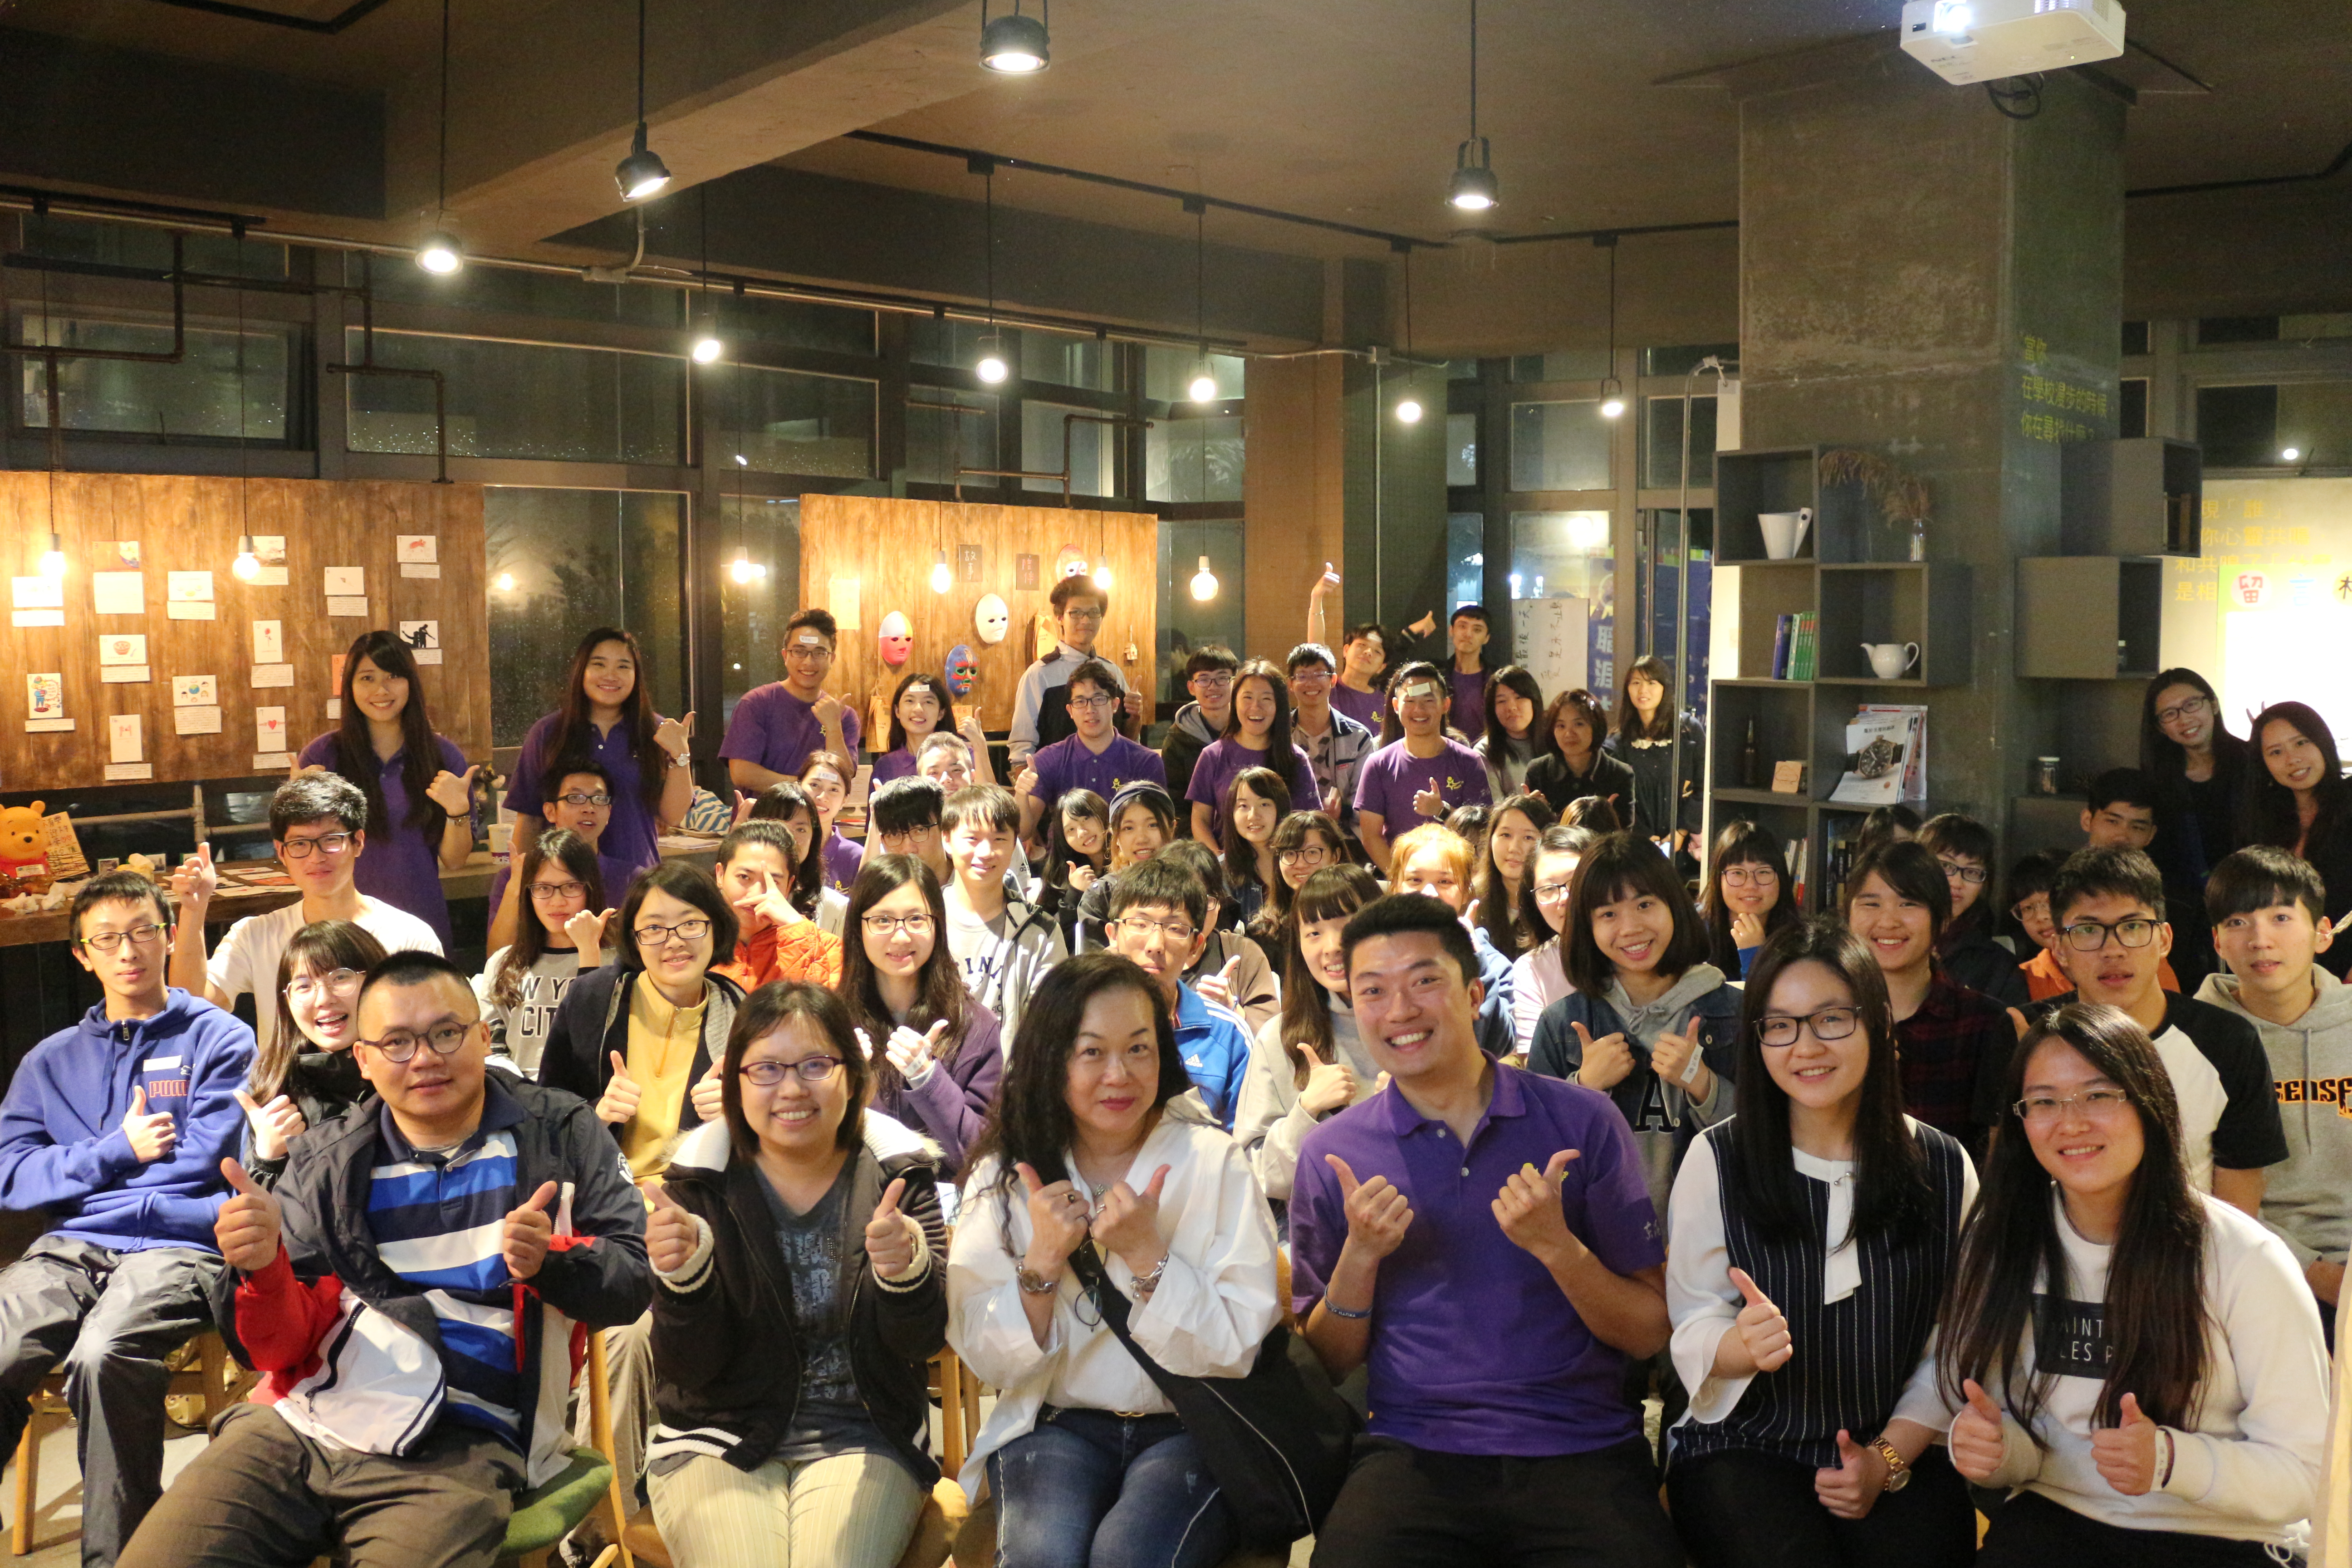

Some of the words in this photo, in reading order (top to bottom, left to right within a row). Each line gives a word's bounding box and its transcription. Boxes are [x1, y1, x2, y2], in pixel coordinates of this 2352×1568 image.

[965, 550, 977, 580] 故事
[1022, 558, 1034, 585] 陪伴
[149, 1080, 190, 1098] PUM
[1634, 1068, 1676, 1133] A
